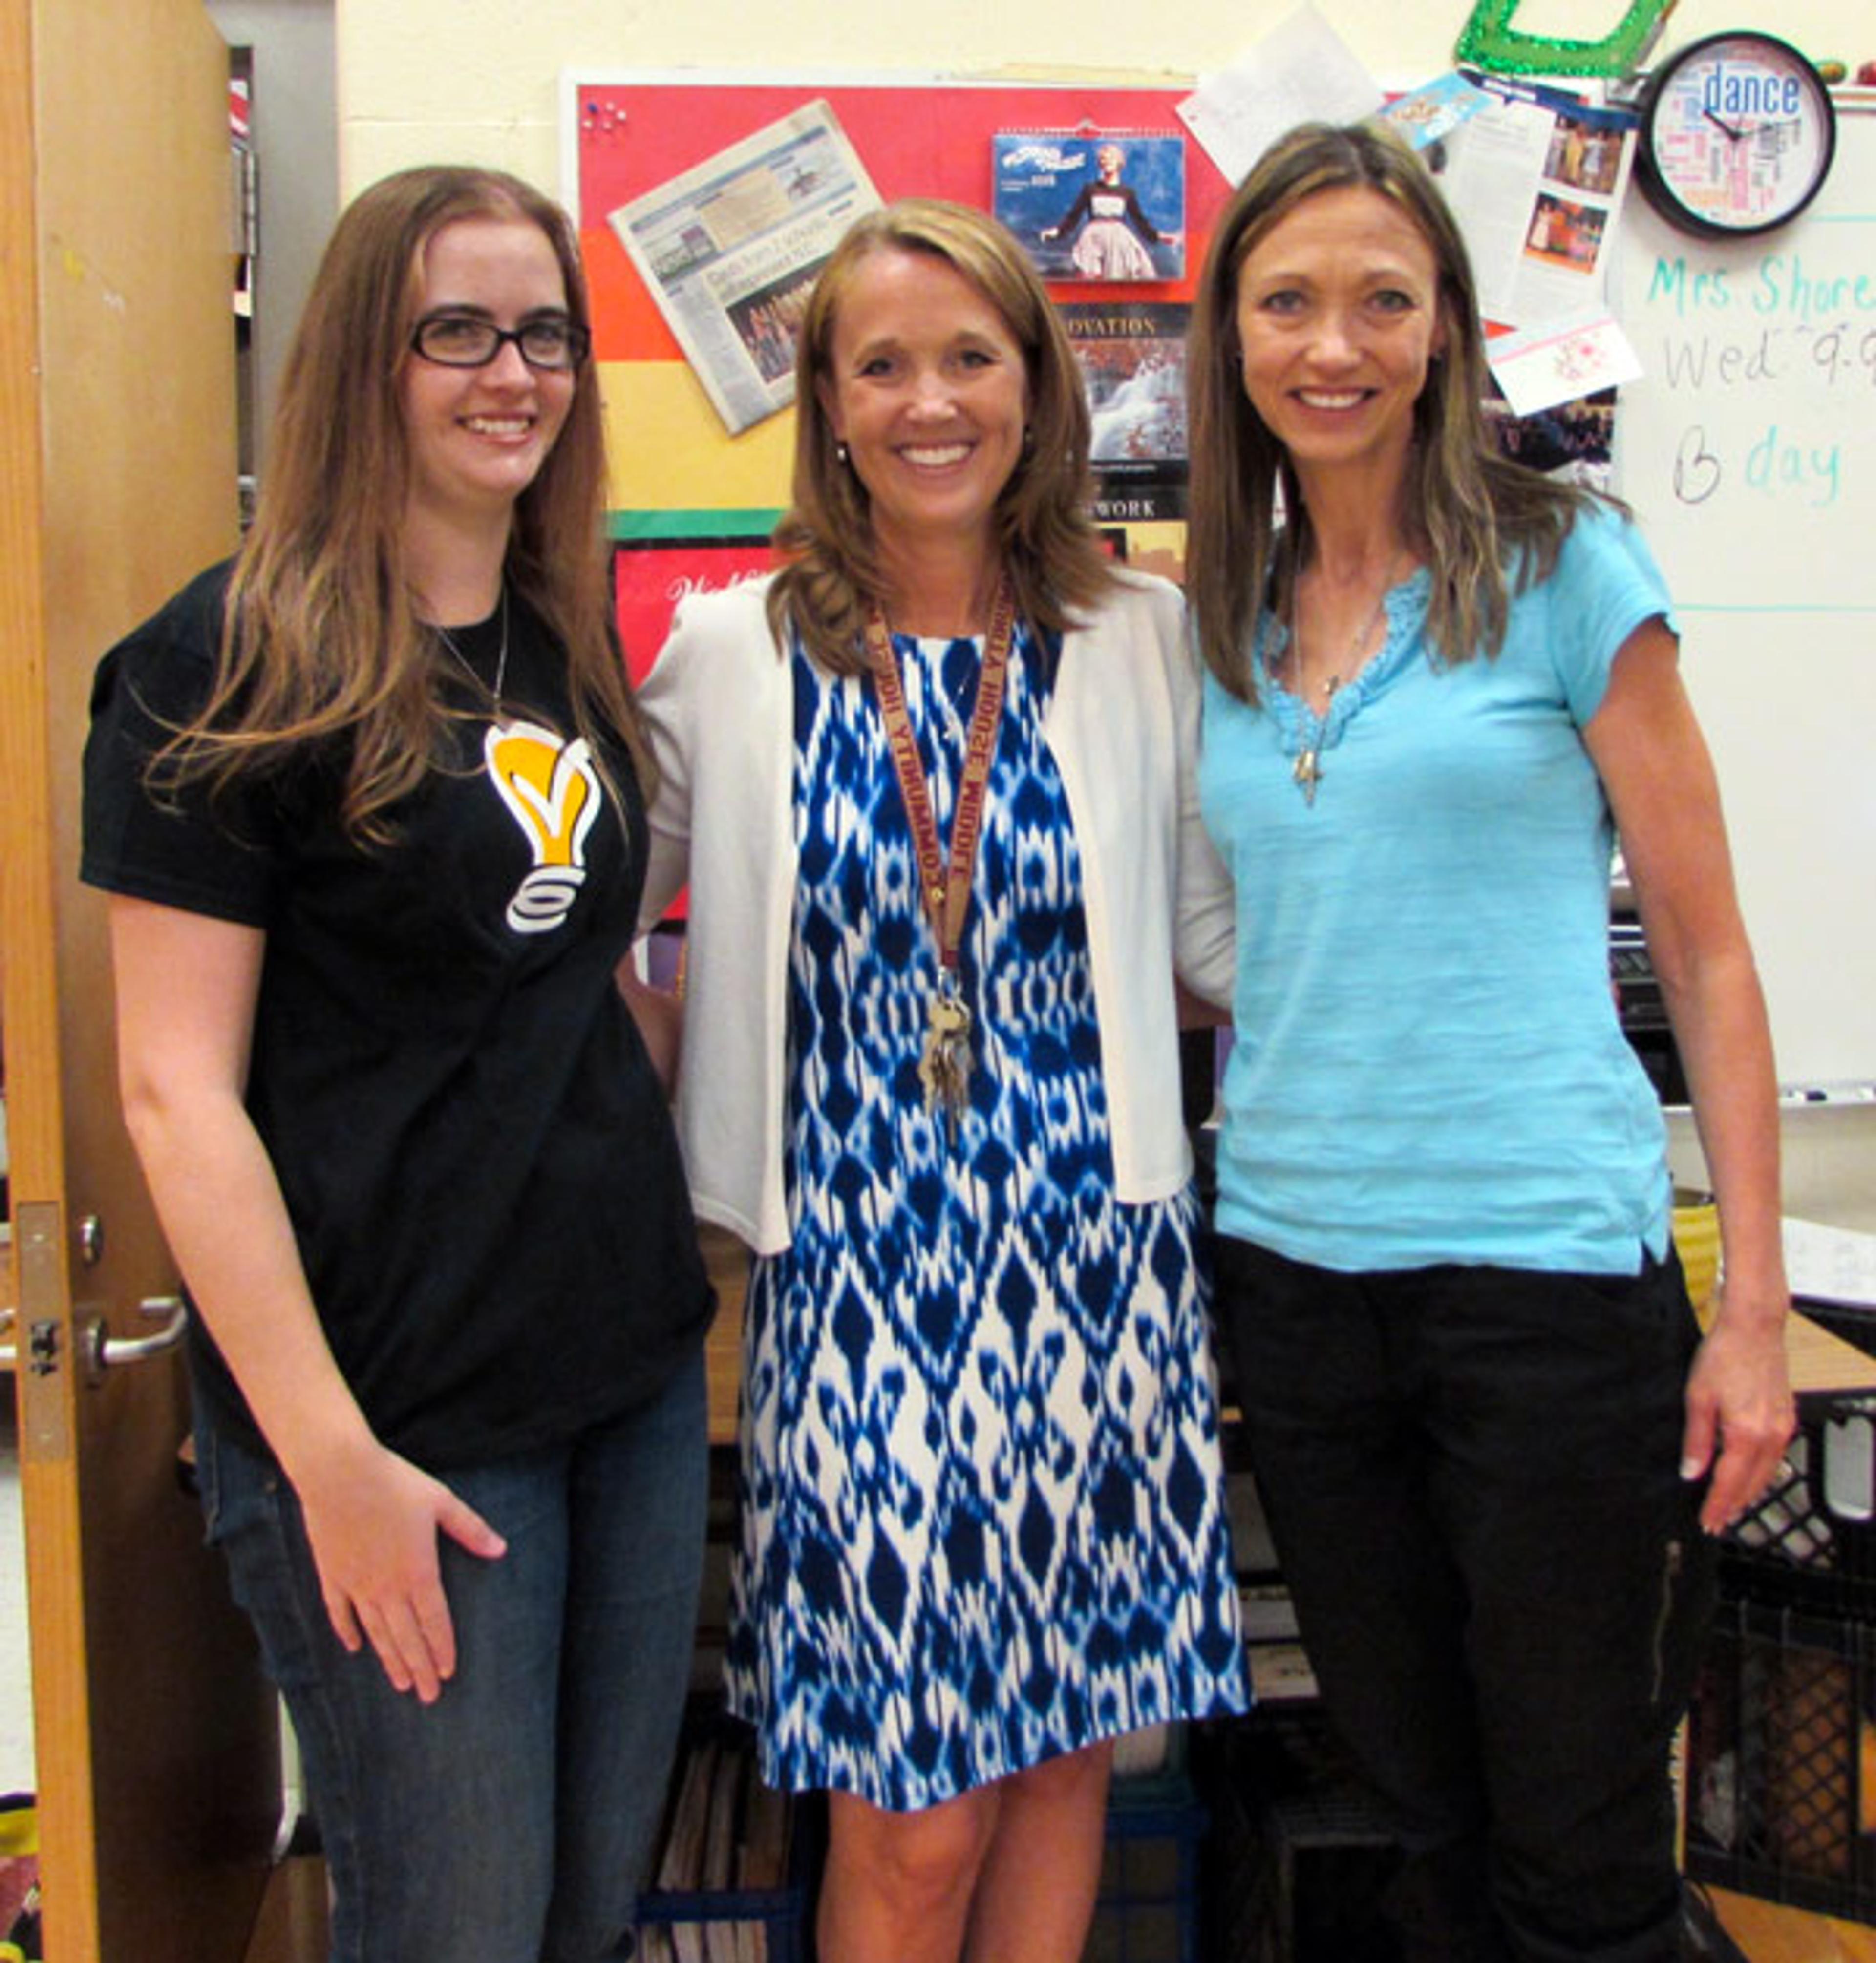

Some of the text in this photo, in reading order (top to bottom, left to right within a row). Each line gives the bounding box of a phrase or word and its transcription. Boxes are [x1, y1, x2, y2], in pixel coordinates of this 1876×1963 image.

[1705, 61, 1800, 114] dance
[1069, 318, 1155, 335] OVATION
[1663, 329, 1777, 388] Wed
[1673, 424, 1840, 507] B day
[1096, 499, 1155, 518] WORK
